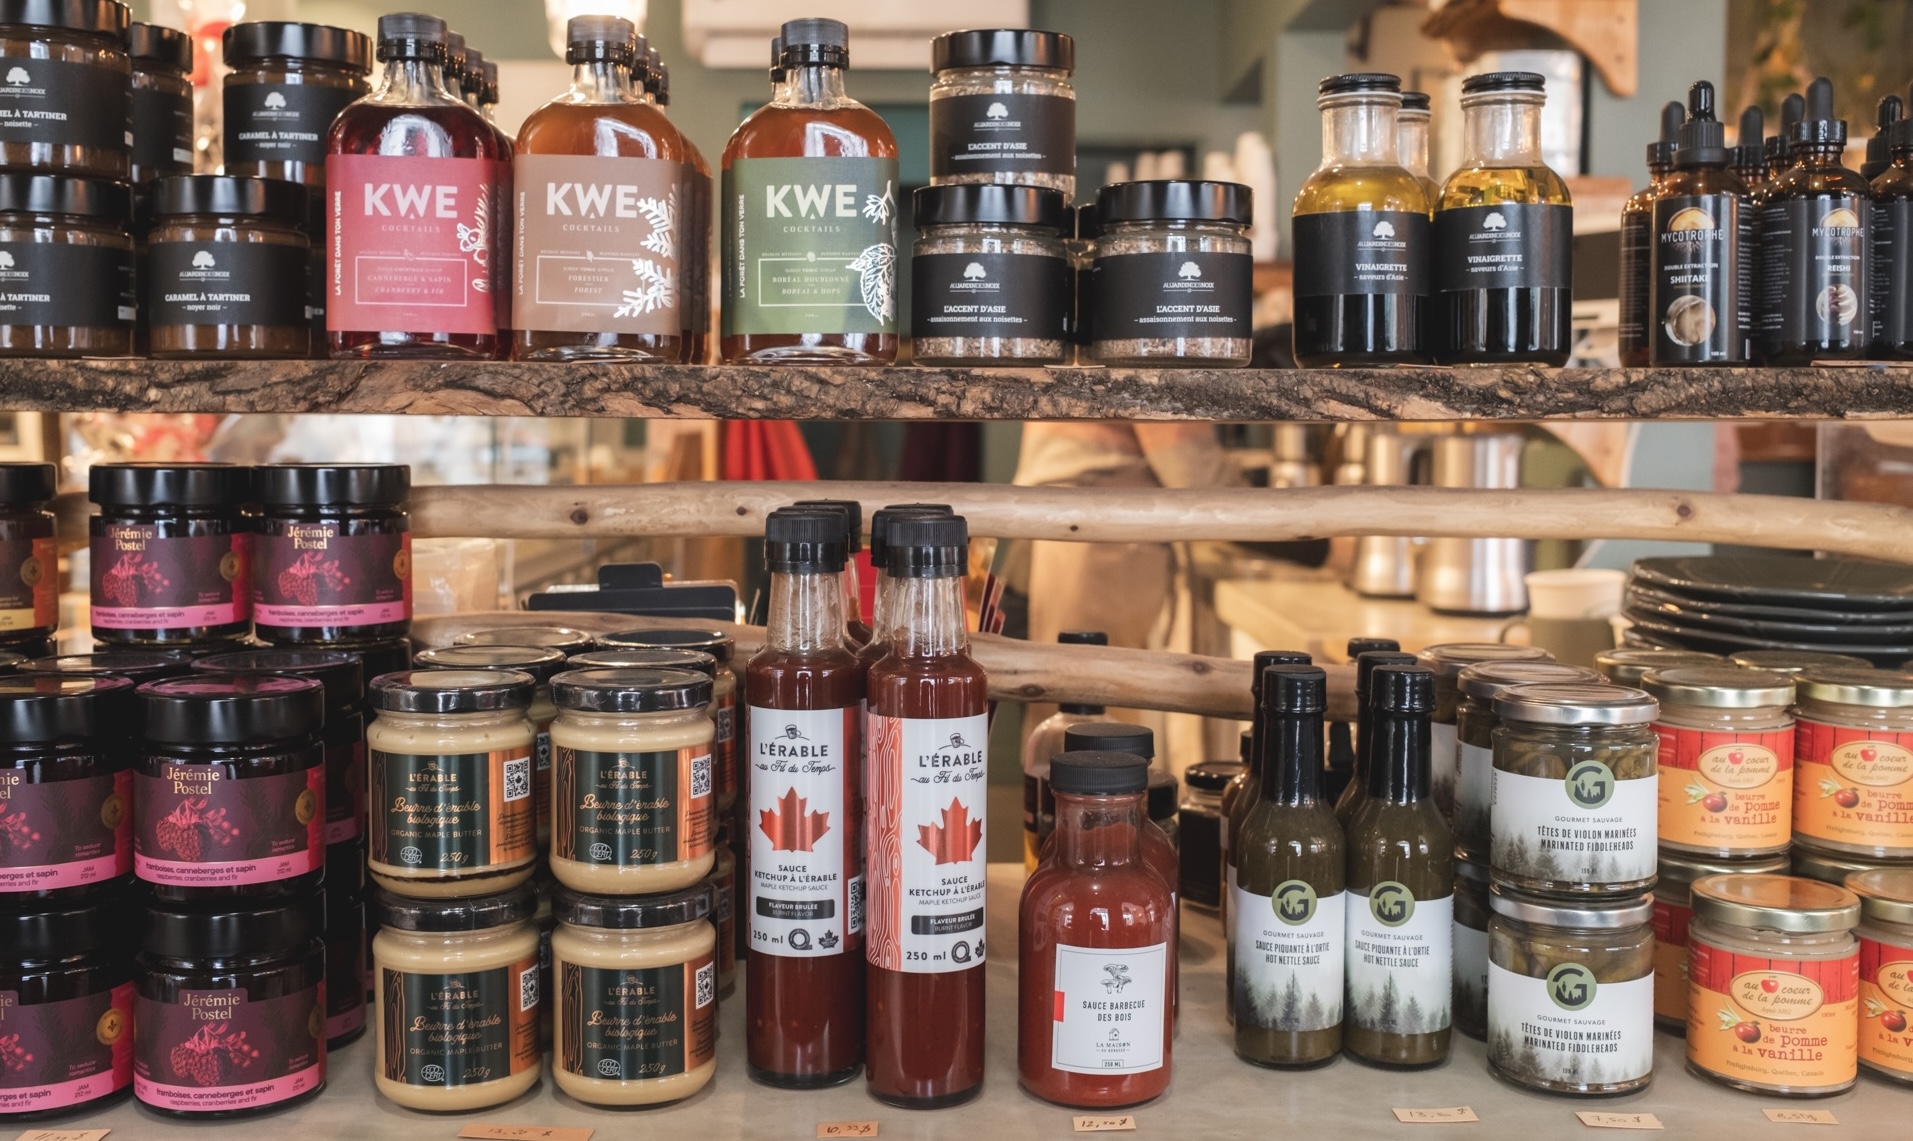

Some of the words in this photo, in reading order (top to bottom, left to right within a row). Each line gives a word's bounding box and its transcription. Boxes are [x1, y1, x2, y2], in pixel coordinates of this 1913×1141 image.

[22, 110, 67, 121] TARTINER
[239, 132, 270, 140] CARAMEL
[279, 132, 318, 141] TARTINER
[1003, 142, 1027, 150] D'ASIE
[365, 183, 458, 219] KWE
[547, 183, 638, 219] KWE
[766, 184, 857, 219] KWE
[381, 225, 440, 233] COCKTAILS
[563, 224, 620, 233] COCKTAILS
[1812, 228, 1863, 238] MYCOTROPHE
[1661, 229, 1724, 243] MYCOTROPHE
[1468, 254, 1522, 263] VINAIGRETTE
[773, 275, 801, 283] BORÉAL
[804, 275, 849, 283] HOUBLONNÉ
[1670, 274, 1710, 284] SHIITAKE
[109, 527, 152, 539] Jérémie
[288, 526, 334, 538] Jérémie
[115, 539, 146, 550] Postel
[294, 538, 327, 550] Postel
[760, 742, 828, 757] L'ÉRABLE
[919, 750, 982, 767] L'ÉRABLE
[802, 760, 831, 775] Temps
[167, 767, 220, 781] Jérémie
[409, 772, 457, 782] L'ÉRABLE
[600, 769, 647, 779] L'ÉRABLE
[174, 781, 212, 794] Postel
[1735, 793, 1766, 801] beurre
[1867, 790, 1902, 799] beurre
[391, 796, 432, 813] Beurre
[434, 801, 481, 813] d'érable
[580, 794, 622, 809] Beurre
[624, 798, 670, 810] d'érable
[1744, 801, 1780, 813] pomme
[406, 812, 459, 828] biologique
[597, 810, 648, 824] biologique
[1724, 814, 1777, 825] vanille
[391, 830, 422, 838] ORGANIC
[453, 830, 482, 838] BUTTER
[580, 826, 613, 834] ORGANIC
[643, 826, 670, 834] BUTTER
[1537, 825, 1559, 838] TÊTES
[1562, 829, 1570, 838] DE
[1574, 829, 1602, 839] VIOLON
[1604, 828, 1636, 839] MARINÉES
[1541, 839, 1584, 851] MARINATED
[1587, 841, 1633, 852] FIDDLEHEADS
[176, 867, 224, 875] canneberges
[236, 864, 256, 873] sapin
[755, 870, 787, 882] KETCHUP
[790, 873, 796, 882] À
[799, 872, 837, 883] L'ÉRABLE
[942, 876, 968, 885] SAUCE
[761, 882, 777, 890] MAPLE
[909, 888, 951, 896] KETCHUP
[953, 886, 959, 895] À
[961, 880, 985, 894] L'ÉRABLE
[769, 902, 793, 910] FLAVEUR
[795, 902, 818, 910] BRULÉE
[942, 897, 967, 905] KETCHUP
[930, 915, 956, 925] FLAVEUR
[958, 914, 975, 922] BRULÉE
[753, 930, 768, 941] 250
[772, 935, 783, 943] ml
[1263, 930, 1294, 938] GOURMET
[1361, 930, 1391, 939] GOURMET
[1256, 940, 1272, 952] SAUCE
[1274, 943, 1304, 954] PIQUANTE
[1311, 942, 1329, 953] L'ORTIE
[906, 951, 927, 960] 250
[933, 951, 946, 960] ml
[1266, 954, 1277, 963] HOT
[1279, 955, 1301, 965] NETTLE
[1302, 955, 1320, 965] SAUCE
[1364, 954, 1374, 964] HOT
[1375, 956, 1398, 967] NETTLE
[1399, 958, 1419, 967] SAUCE
[608, 987, 655, 996] L'ÉRABLE
[1744, 981, 1759, 990] au
[1782, 986, 1811, 995] coeur
[184, 993, 240, 1007] Jérémie
[431, 990, 479, 1000] L'ÉRABLE
[1742, 992, 1754, 1001] de
[1757, 992, 1768, 1003] la
[1772, 995, 1813, 1006] pomme
[1083, 1001, 1107, 1010] SAUCE
[1110, 1000, 1145, 1010] BARBECUE
[192, 1007, 232, 1020] Postel
[1115, 1013, 1132, 1021] BOIS
[1537, 1015, 1571, 1024] GOURMET
[1521, 1022, 1541, 1036] TÊTES
[1544, 1028, 1553, 1038] DE
[1556, 1029, 1583, 1041] VIOLON
[1586, 1030, 1621, 1041] MARINÉES
[1769, 1024, 1806, 1034] beurre
[1524, 1036, 1566, 1052] MARINATED
[1568, 1042, 1618, 1053] FIDDLEHEADS
[1763, 1035, 1775, 1044] de
[1780, 1035, 1828, 1047] pomme
[1741, 1045, 1753, 1055] la
[1757, 1047, 1823, 1062] vanille
[193, 1089, 244, 1099] canneberges
[255, 1084, 274, 1095] sapin
